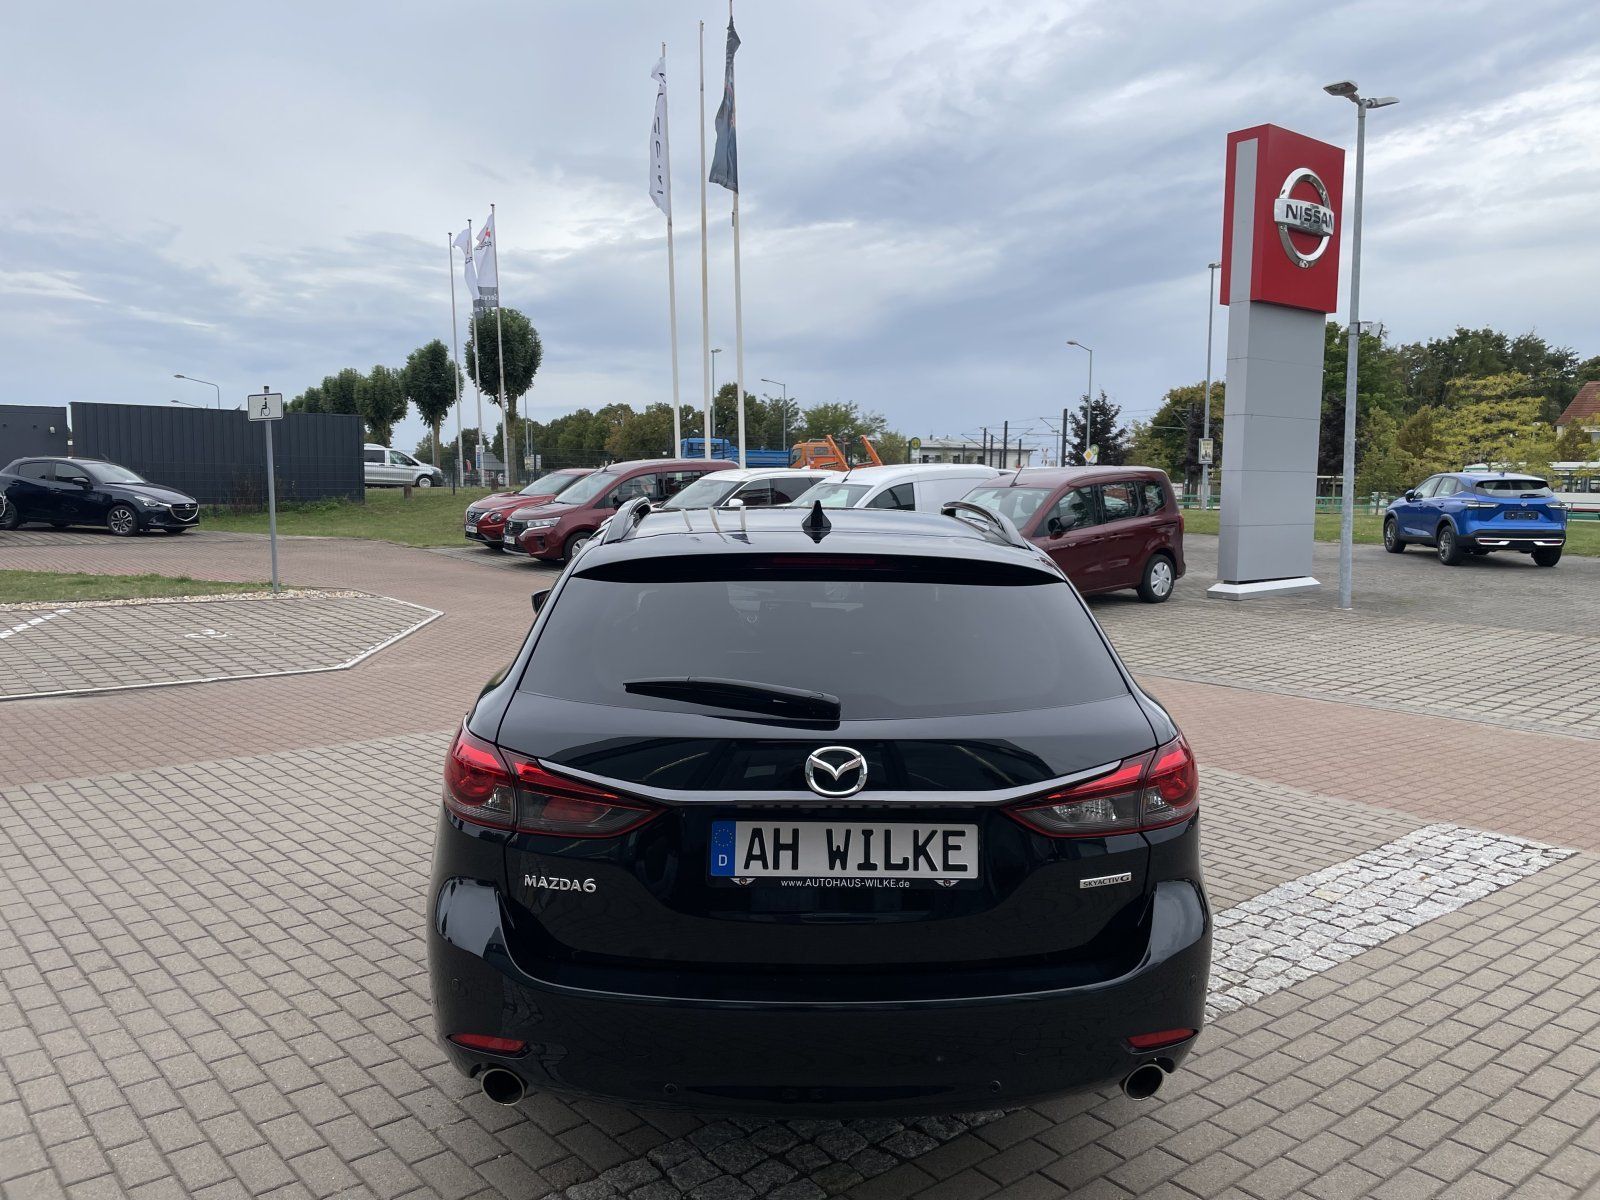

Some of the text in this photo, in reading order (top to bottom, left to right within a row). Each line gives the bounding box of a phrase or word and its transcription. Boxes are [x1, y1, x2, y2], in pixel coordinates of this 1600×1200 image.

[743, 827, 968, 872] AH WILKE
[718, 854, 728, 867] D
[524, 874, 597, 893] MAZDA6
[780, 878, 910, 888] www.AUTOHAUS-WILKE.de
